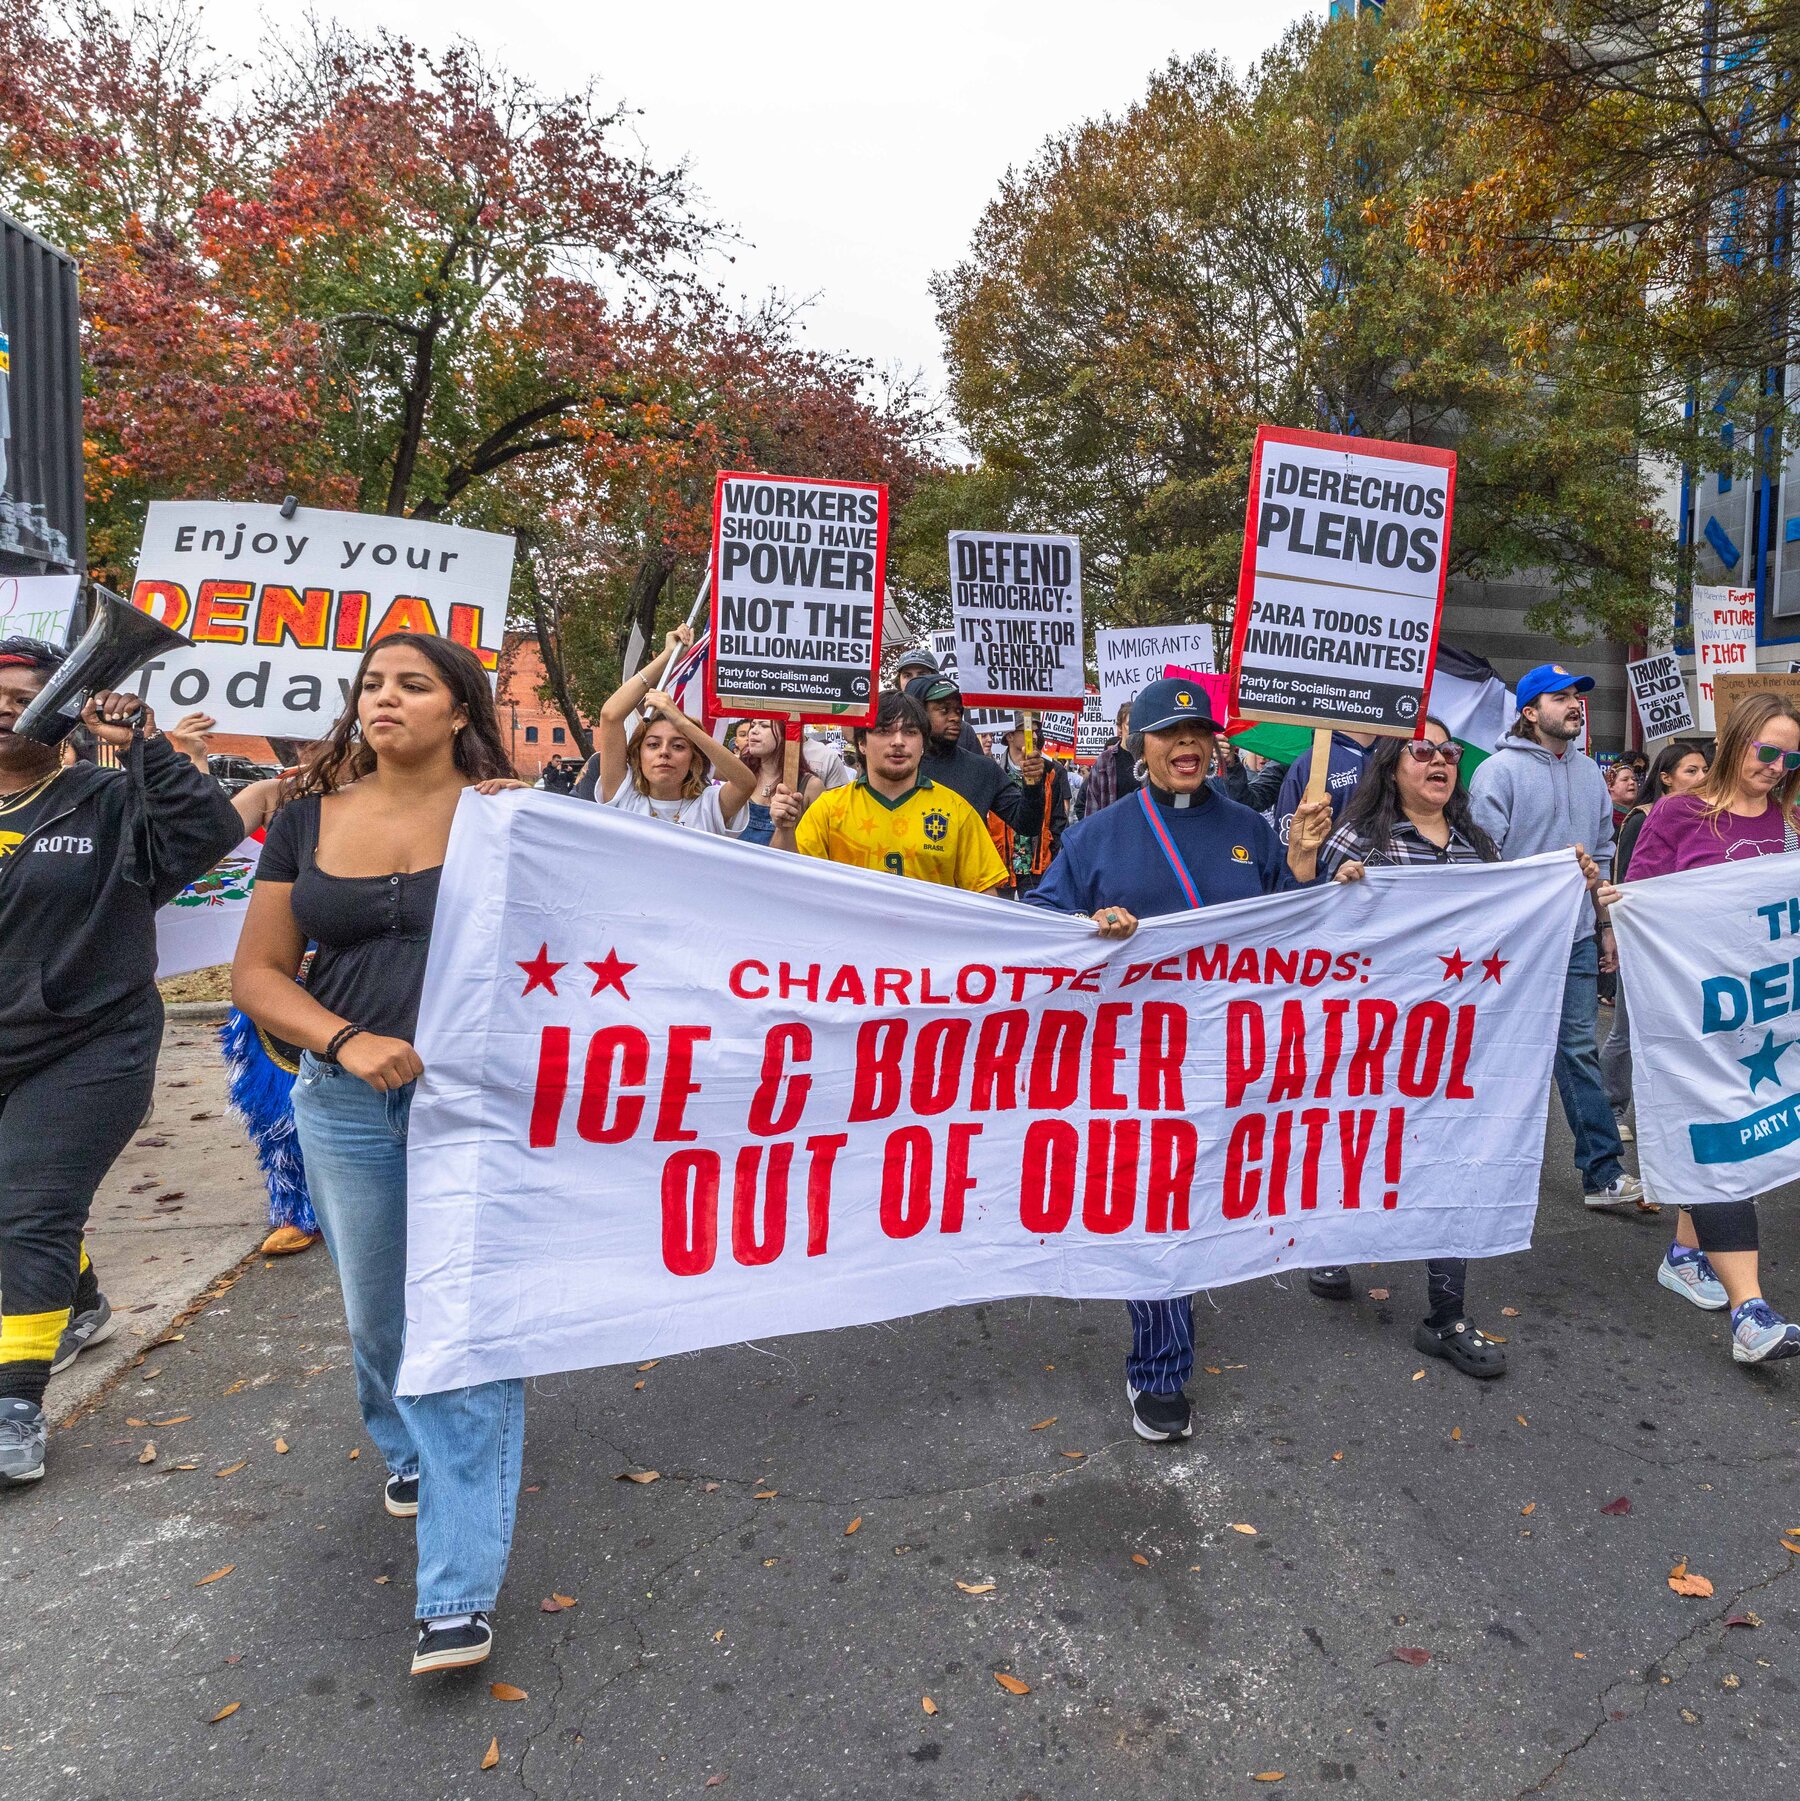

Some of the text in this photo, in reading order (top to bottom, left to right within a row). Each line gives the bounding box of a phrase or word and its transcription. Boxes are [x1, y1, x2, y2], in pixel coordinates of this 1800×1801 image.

[724, 483, 878, 524] WORKERS
[1264, 463, 1445, 519] ¡DERECHOS
[175, 522, 458, 572] Enjoy your
[722, 517, 877, 550] SHOULD HAVE
[1257, 502, 1438, 573] PLENOS
[722, 541, 874, 592] POWER
[957, 540, 1072, 587] DEFEND
[957, 582, 1073, 613] DEMOCRACY:
[131, 578, 501, 671] DENIAL
[721, 596, 873, 640] NOT THE
[960, 618, 1075, 646] IT'S TIME FOR
[1248, 601, 1429, 643] PARA TODOS LOS
[1713, 609, 1755, 626] FUTURE
[720, 635, 871, 664] BILLIONAIRES!
[1108, 636, 1201, 661] IMMIGRANTS
[1701, 630, 1720, 640] NOW
[974, 643, 986, 666] A
[988, 643, 1065, 669] GENERAL
[1243, 628, 1425, 674] INMIGRANTES!
[718, 667, 829, 682] Party for Socialism and
[987, 667, 1053, 691] STRIKE!
[1104, 668, 1140, 688] MAKE
[1630, 656, 1676, 685] TRUMP:
[718, 678, 766, 690] Liberation
[780, 682, 841, 697] PSLWeb.org
[1240, 675, 1370, 700] Party for Socialism and
[1635, 675, 1681, 699] END
[1640, 692, 1685, 710] THE WAR
[1045, 713, 1058, 722] NO
[1239, 688, 1295, 705] Liberation
[1313, 698, 1383, 719] PSLWeb.org
[1649, 701, 1682, 722] ON
[1078, 727, 1114, 736] NO PARA
[1646, 714, 1691, 738] IMMIGRANTS
[1331, 774, 1358, 789] RESIST
[33, 836, 93, 854] ROTB
[728, 944, 1371, 1006] CHARLOTTE DEMANDS:
[530, 1024, 712, 1148] ICE
[847, 1001, 1188, 1123] BORDER
[1225, 999, 1476, 1109] PATROL
[1740, 1109, 1790, 1145] PARTY
[661, 1107, 1404, 1277] OUT OF OUR CITY!
